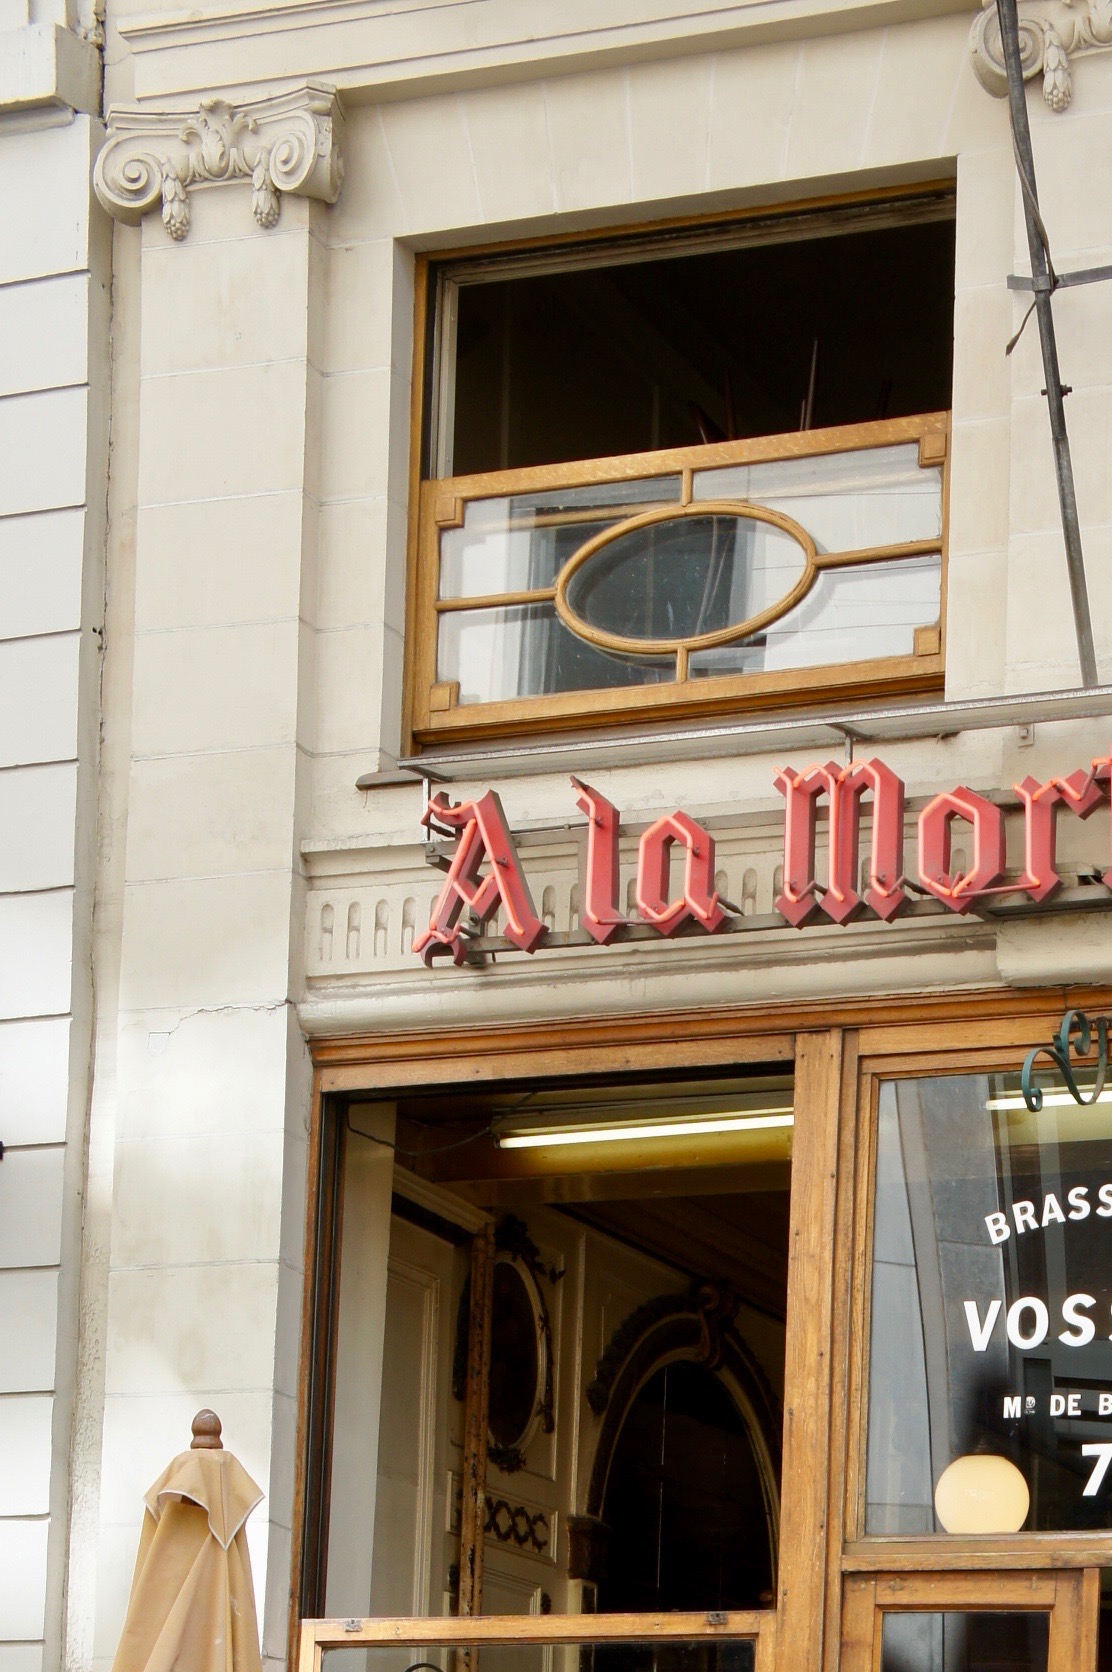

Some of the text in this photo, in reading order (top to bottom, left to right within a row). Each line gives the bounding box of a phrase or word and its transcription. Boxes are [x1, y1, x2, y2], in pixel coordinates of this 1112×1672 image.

[411, 790, 549, 968] A
[570, 775, 731, 946] la
[1050, 1394, 1082, 1416] DE
